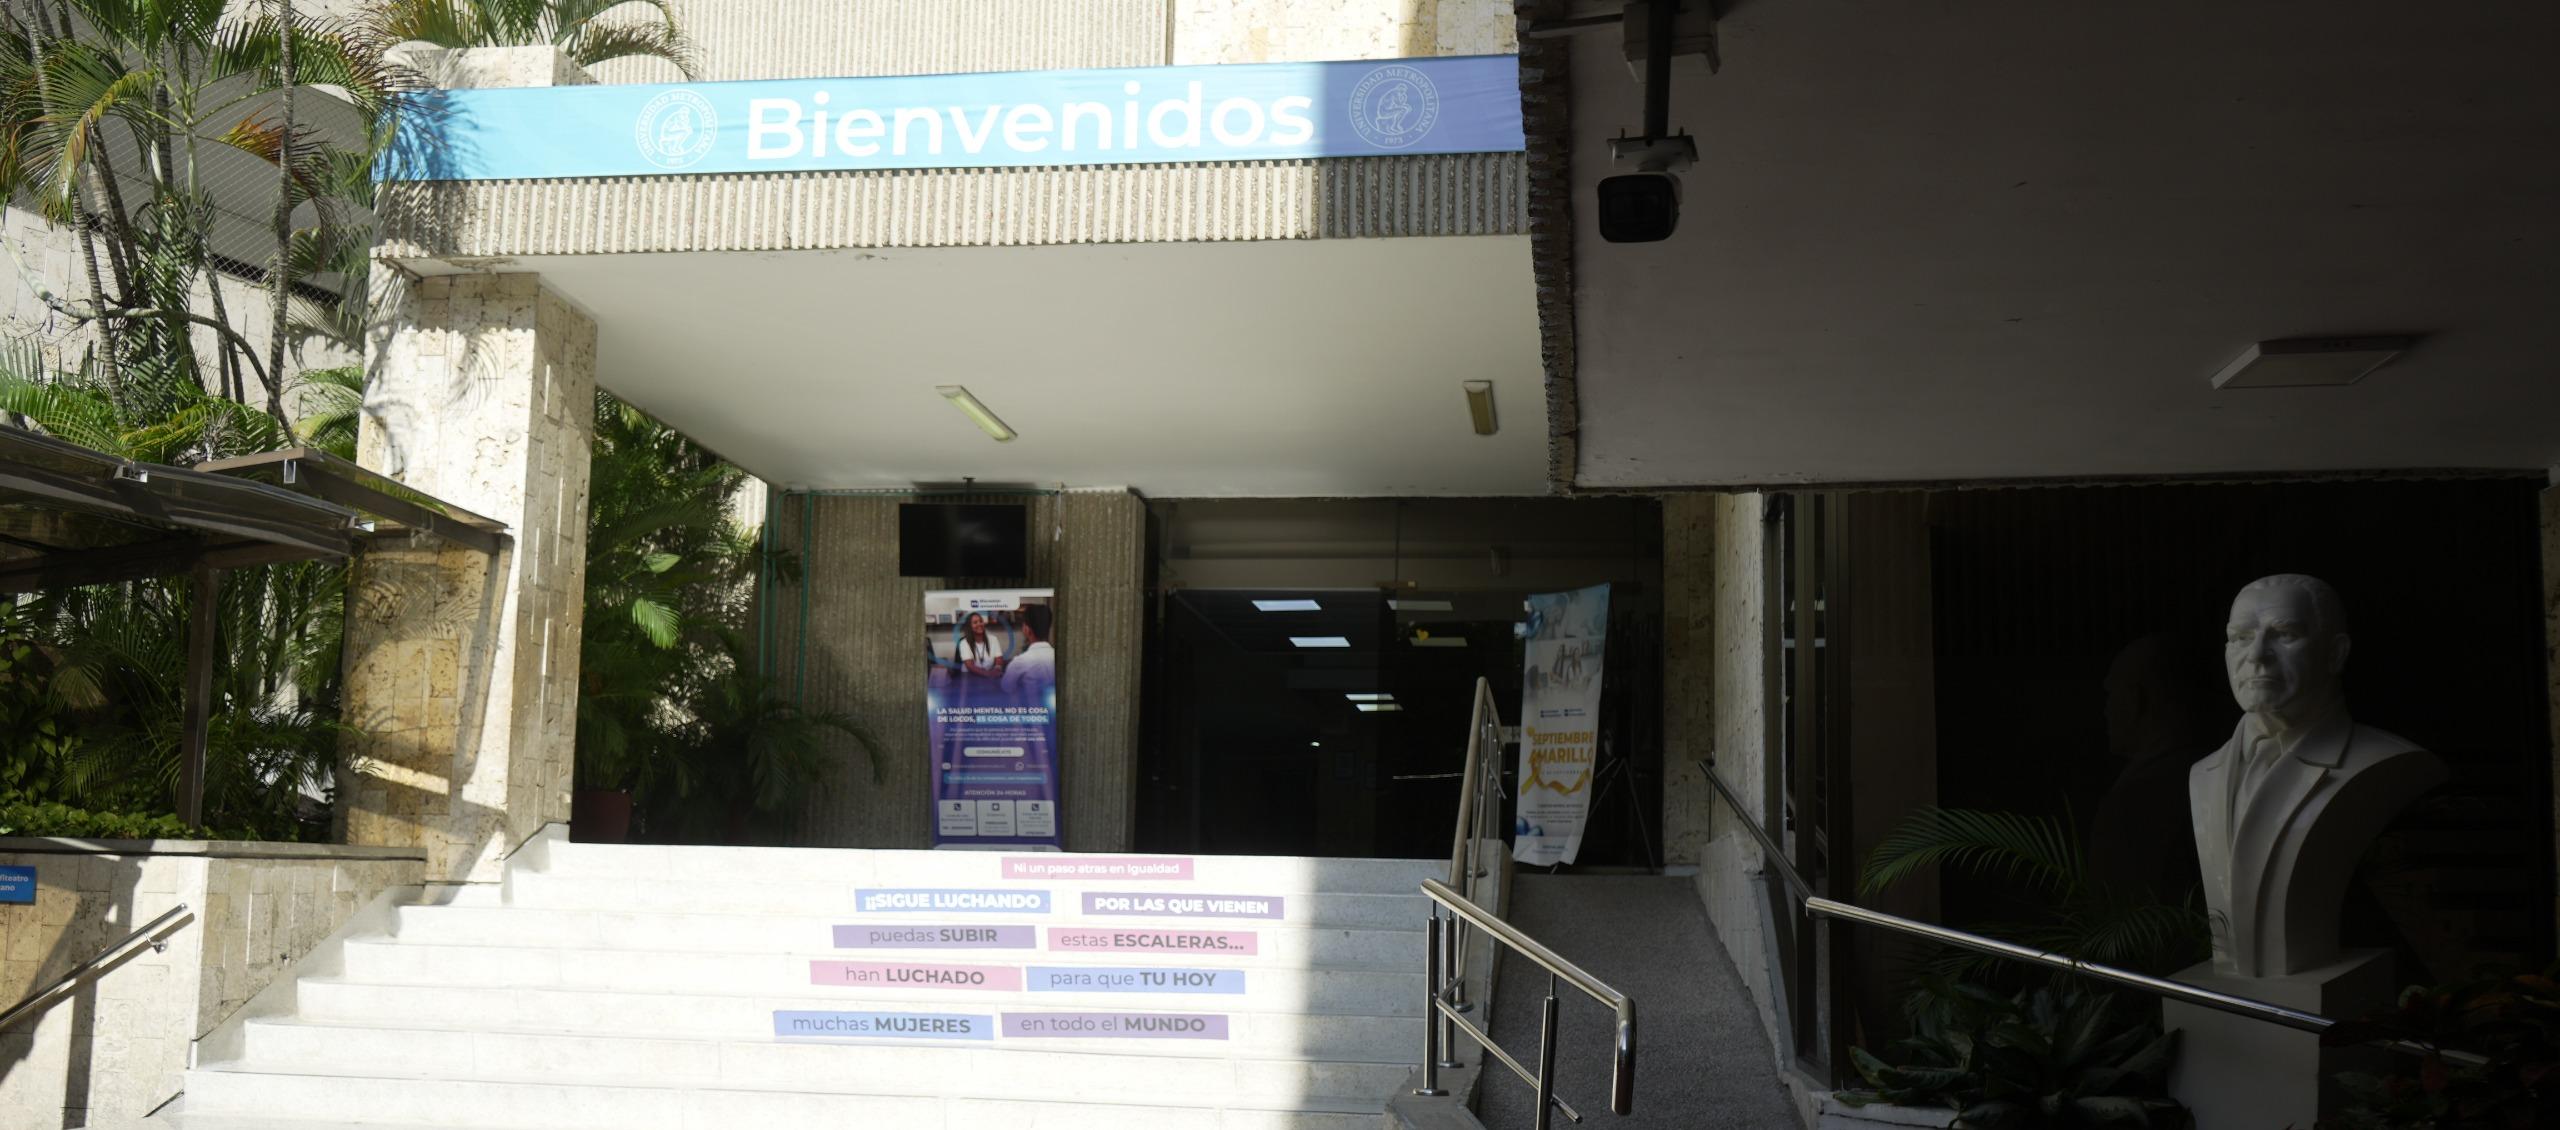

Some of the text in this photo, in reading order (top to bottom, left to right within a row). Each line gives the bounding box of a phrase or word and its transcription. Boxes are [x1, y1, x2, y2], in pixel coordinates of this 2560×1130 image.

[746, 80, 1315, 159] Bienvenidos
[937, 706, 947, 714] LA
[974, 706, 1004, 714] MENTAL
[1006, 706, 1017, 714] NO
[988, 715, 1008, 723] COSA
[1532, 731, 1594, 745] SEPTIEMBRE
[1014, 863, 1026, 873] Ni
[1029, 865, 1045, 873] un
[1048, 865, 1075, 876] paso
[1078, 864, 1108, 874] atras
[1110, 866, 1124, 874] en
[934, 894, 1040, 908] LUCHANDO
[1095, 898, 1268, 914] POR LAS QUE VIENEN
[870, 928, 998, 944] puedas SUBIR
[1061, 934, 1244, 950] estas ESCALERAS...
[845, 967, 984, 984] han LUCHADO
[1050, 972, 1216, 988] para que TU HOY
[793, 1017, 972, 1032] muchas MUJERES
[1021, 1017, 1206, 1032] en todo el MUNDO
